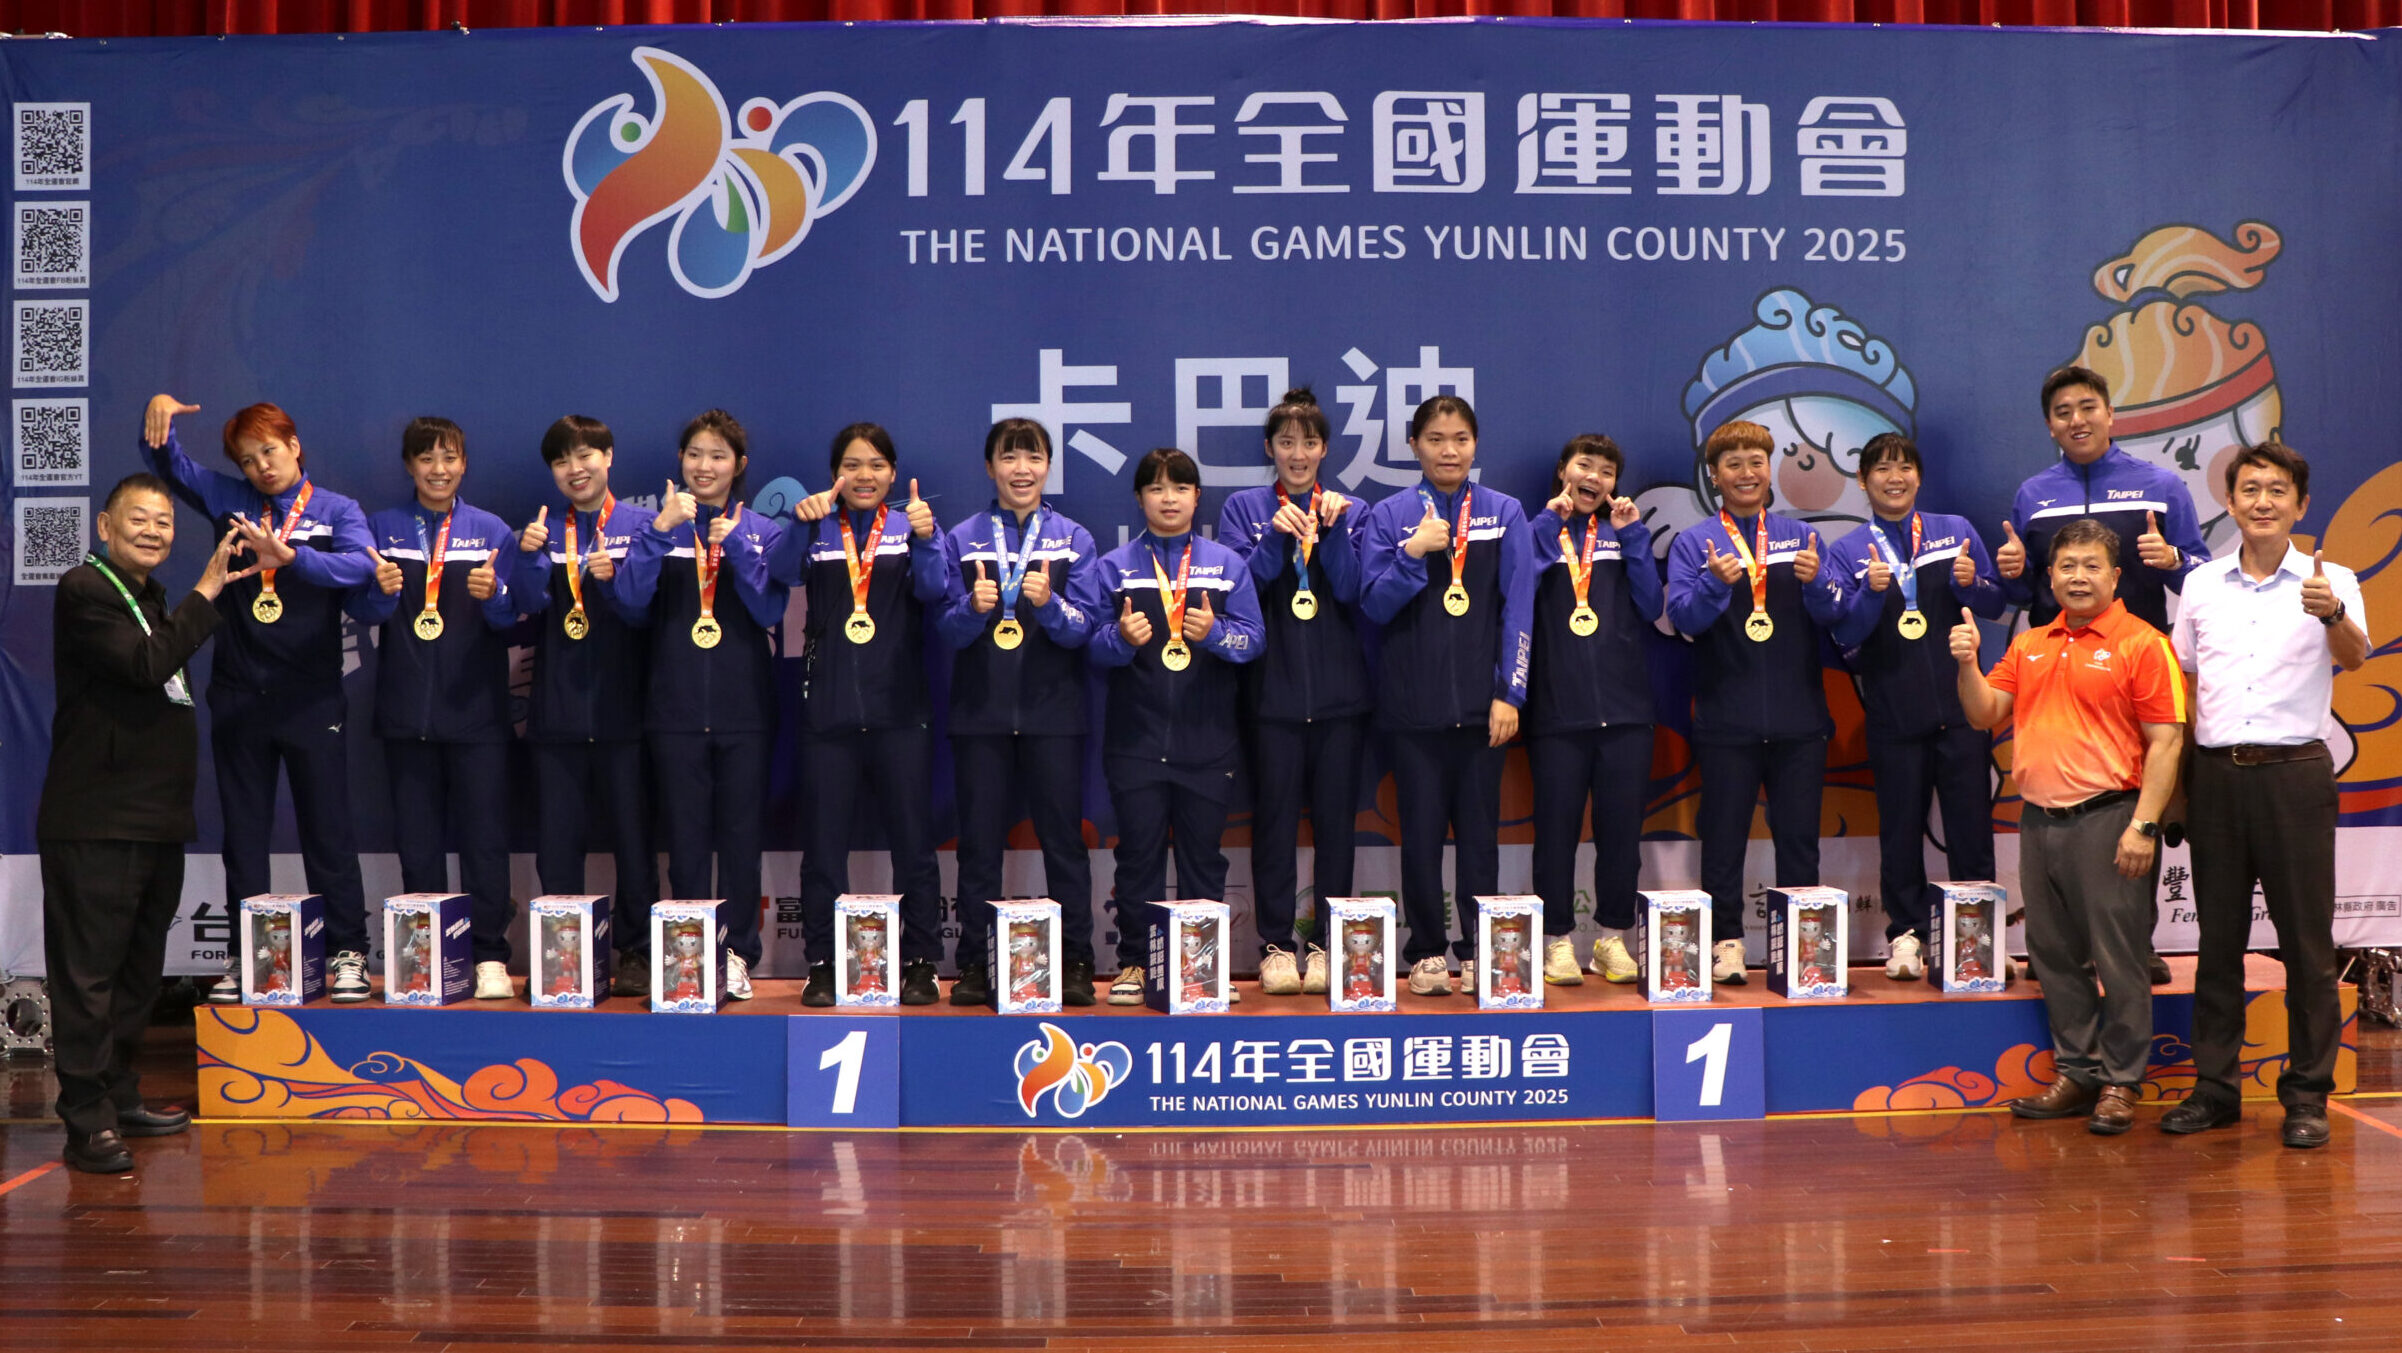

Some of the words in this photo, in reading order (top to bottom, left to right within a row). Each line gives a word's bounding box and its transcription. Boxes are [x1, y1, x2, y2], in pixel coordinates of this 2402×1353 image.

[894, 91, 1906, 196] 114年全國運動會
[901, 230, 985, 263] THE
[1007, 227, 1232, 262] NATIONAL
[1252, 225, 1405, 260] GAMES
[1425, 226, 1586, 260] YUNLIN
[1608, 227, 1785, 261] COUNTY
[1805, 228, 1905, 262] 2025
[992, 346, 1481, 495] 卡巴迪
[2107, 489, 2143, 500] TAIPEI
[1768, 539, 1800, 551] TAIPEI
[1921, 536, 1955, 551] TAIPEI
[1189, 565, 1223, 576] TAIPEI
[1512, 631, 1532, 689] TAIPEI
[819, 1031, 867, 1113] 1
[1147, 1034, 1569, 1083] 114年全國運動會
[1686, 1023, 1732, 1106] 1
[1150, 1097, 1186, 1111] THE
[1193, 1095, 1286, 1111] NATIONAL
[1294, 1094, 1358, 1110] GAMES
[1365, 1092, 1433, 1108] YUNLIN
[1441, 1090, 1516, 1106] COUNTY
[1524, 1089, 1568, 1105] 2025
